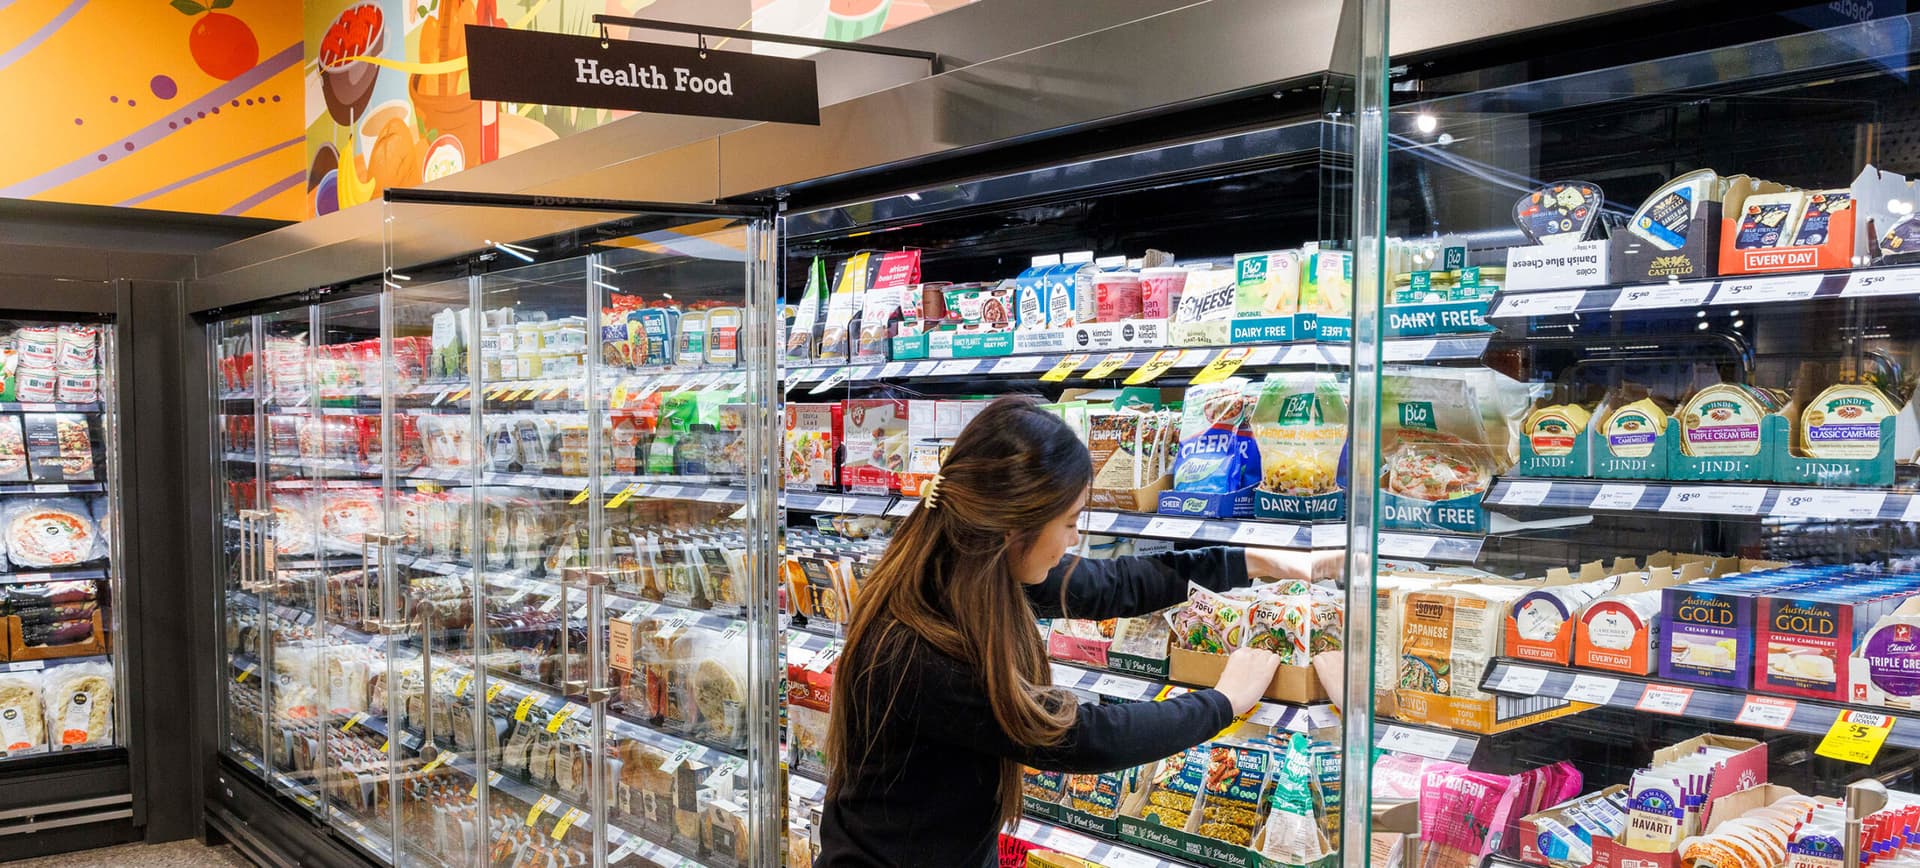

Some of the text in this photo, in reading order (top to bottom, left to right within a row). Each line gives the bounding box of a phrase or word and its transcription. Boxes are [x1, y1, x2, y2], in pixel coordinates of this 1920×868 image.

[574, 58, 734, 96] Health Food
[1512, 255, 1597, 269] Danish Blue Cheese
[1750, 252, 1813, 267] EVERY DAY
[1576, 267, 1597, 276] coles
[1648, 265, 1693, 277] CASTELLO
[1390, 309, 1480, 330] DAIRY FREE
[1092, 329, 1113, 338] kimchi
[1137, 331, 1158, 340] kimchi
[1139, 324, 1157, 333] vegan
[1235, 327, 1263, 339] DAIRY
[1264, 325, 1287, 337] FREE
[1839, 397, 1862, 406] JINDI
[1690, 430, 1758, 441] TRIPLE CREAM BRIE
[1810, 430, 1881, 439] CLASSIC CAMEMBE
[1530, 457, 1566, 470] JINDI
[1608, 459, 1647, 472] JINDI
[1699, 460, 1742, 474] JINDI
[1804, 463, 1851, 477] JINDI
[1261, 497, 1300, 513] DAIRY
[1384, 504, 1476, 525] DAIRY FREE
[1195, 601, 1214, 615] TOFU
[1682, 595, 1731, 609] Australian
[1256, 609, 1278, 622] TOFU
[1679, 605, 1734, 625] GOLD
[1778, 603, 1832, 617] Australian
[1407, 622, 1449, 639] JAPANESE
[1684, 626, 1710, 634] CREAMY
[1775, 614, 1834, 635] GOLD
[1770, 634, 1836, 647] CREAMY CAMEMBERT
[1519, 647, 1554, 659] EVERY DAY
[1591, 654, 1629, 669] EVERY DAY
[1870, 656, 1920, 670] TRIPLE CRE
[1456, 710, 1474, 719] TOFU
[1854, 712, 1880, 721] DOWN
[1849, 724, 1870, 738] $5
[1446, 775, 1487, 800] BACON
[1632, 817, 1673, 836] HAVARTI
